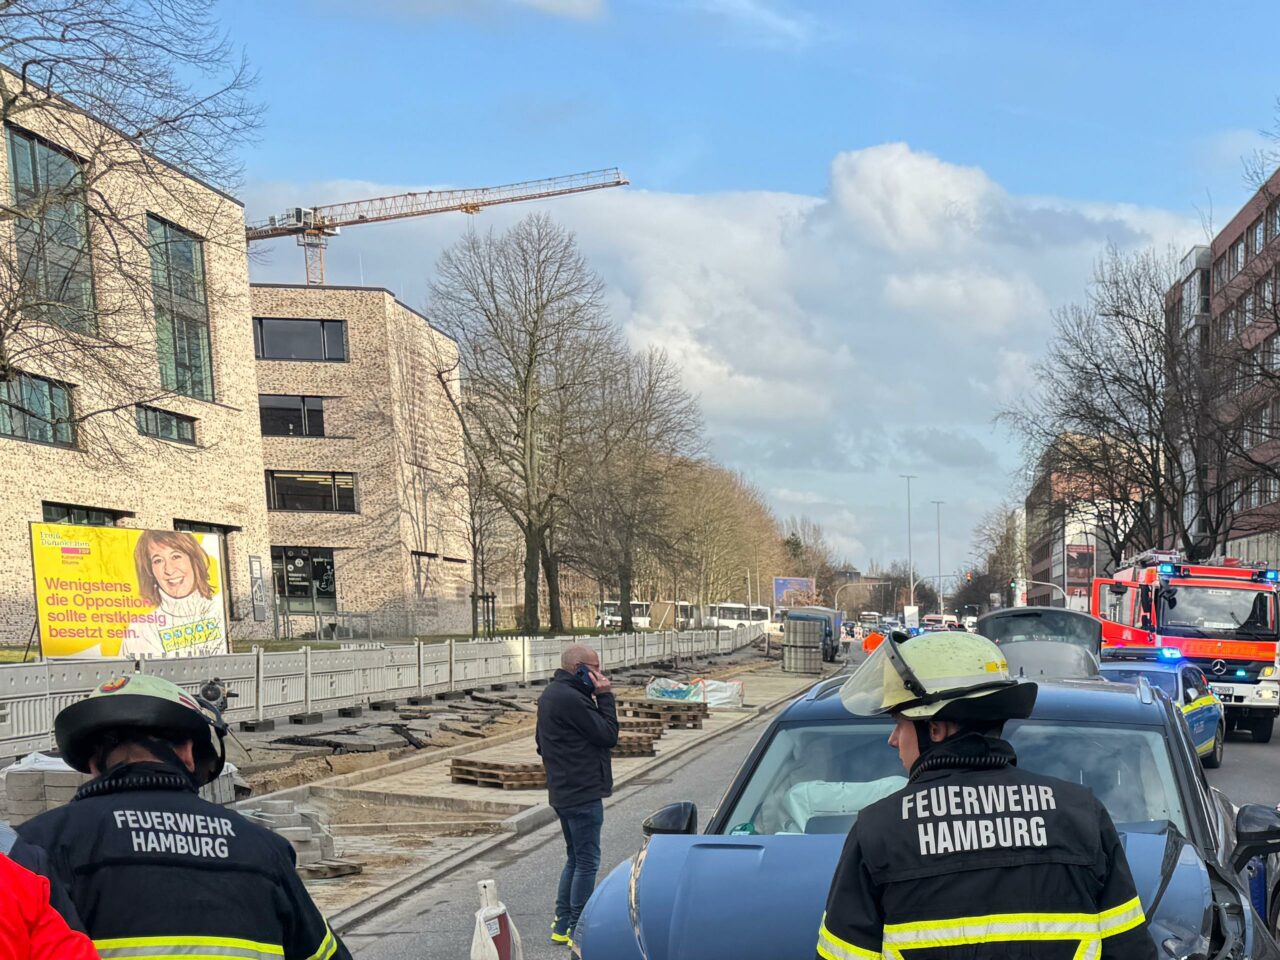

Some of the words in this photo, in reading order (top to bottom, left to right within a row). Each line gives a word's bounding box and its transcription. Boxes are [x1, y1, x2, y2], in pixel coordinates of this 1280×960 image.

[45, 577, 132, 595] Wenigstens
[46, 593, 69, 607] die
[73, 594, 153, 611] Opposition
[47, 610, 87, 622] sollte
[91, 611, 167, 627] erstklassig
[49, 625, 103, 638] besetzt
[107, 627, 140, 639] sein.
[902, 784, 1057, 820] FEUERWEHR
[113, 810, 236, 836] FEUERWEHR
[131, 831, 229, 858] HAMBURG
[917, 816, 1048, 855] HAMBURG
